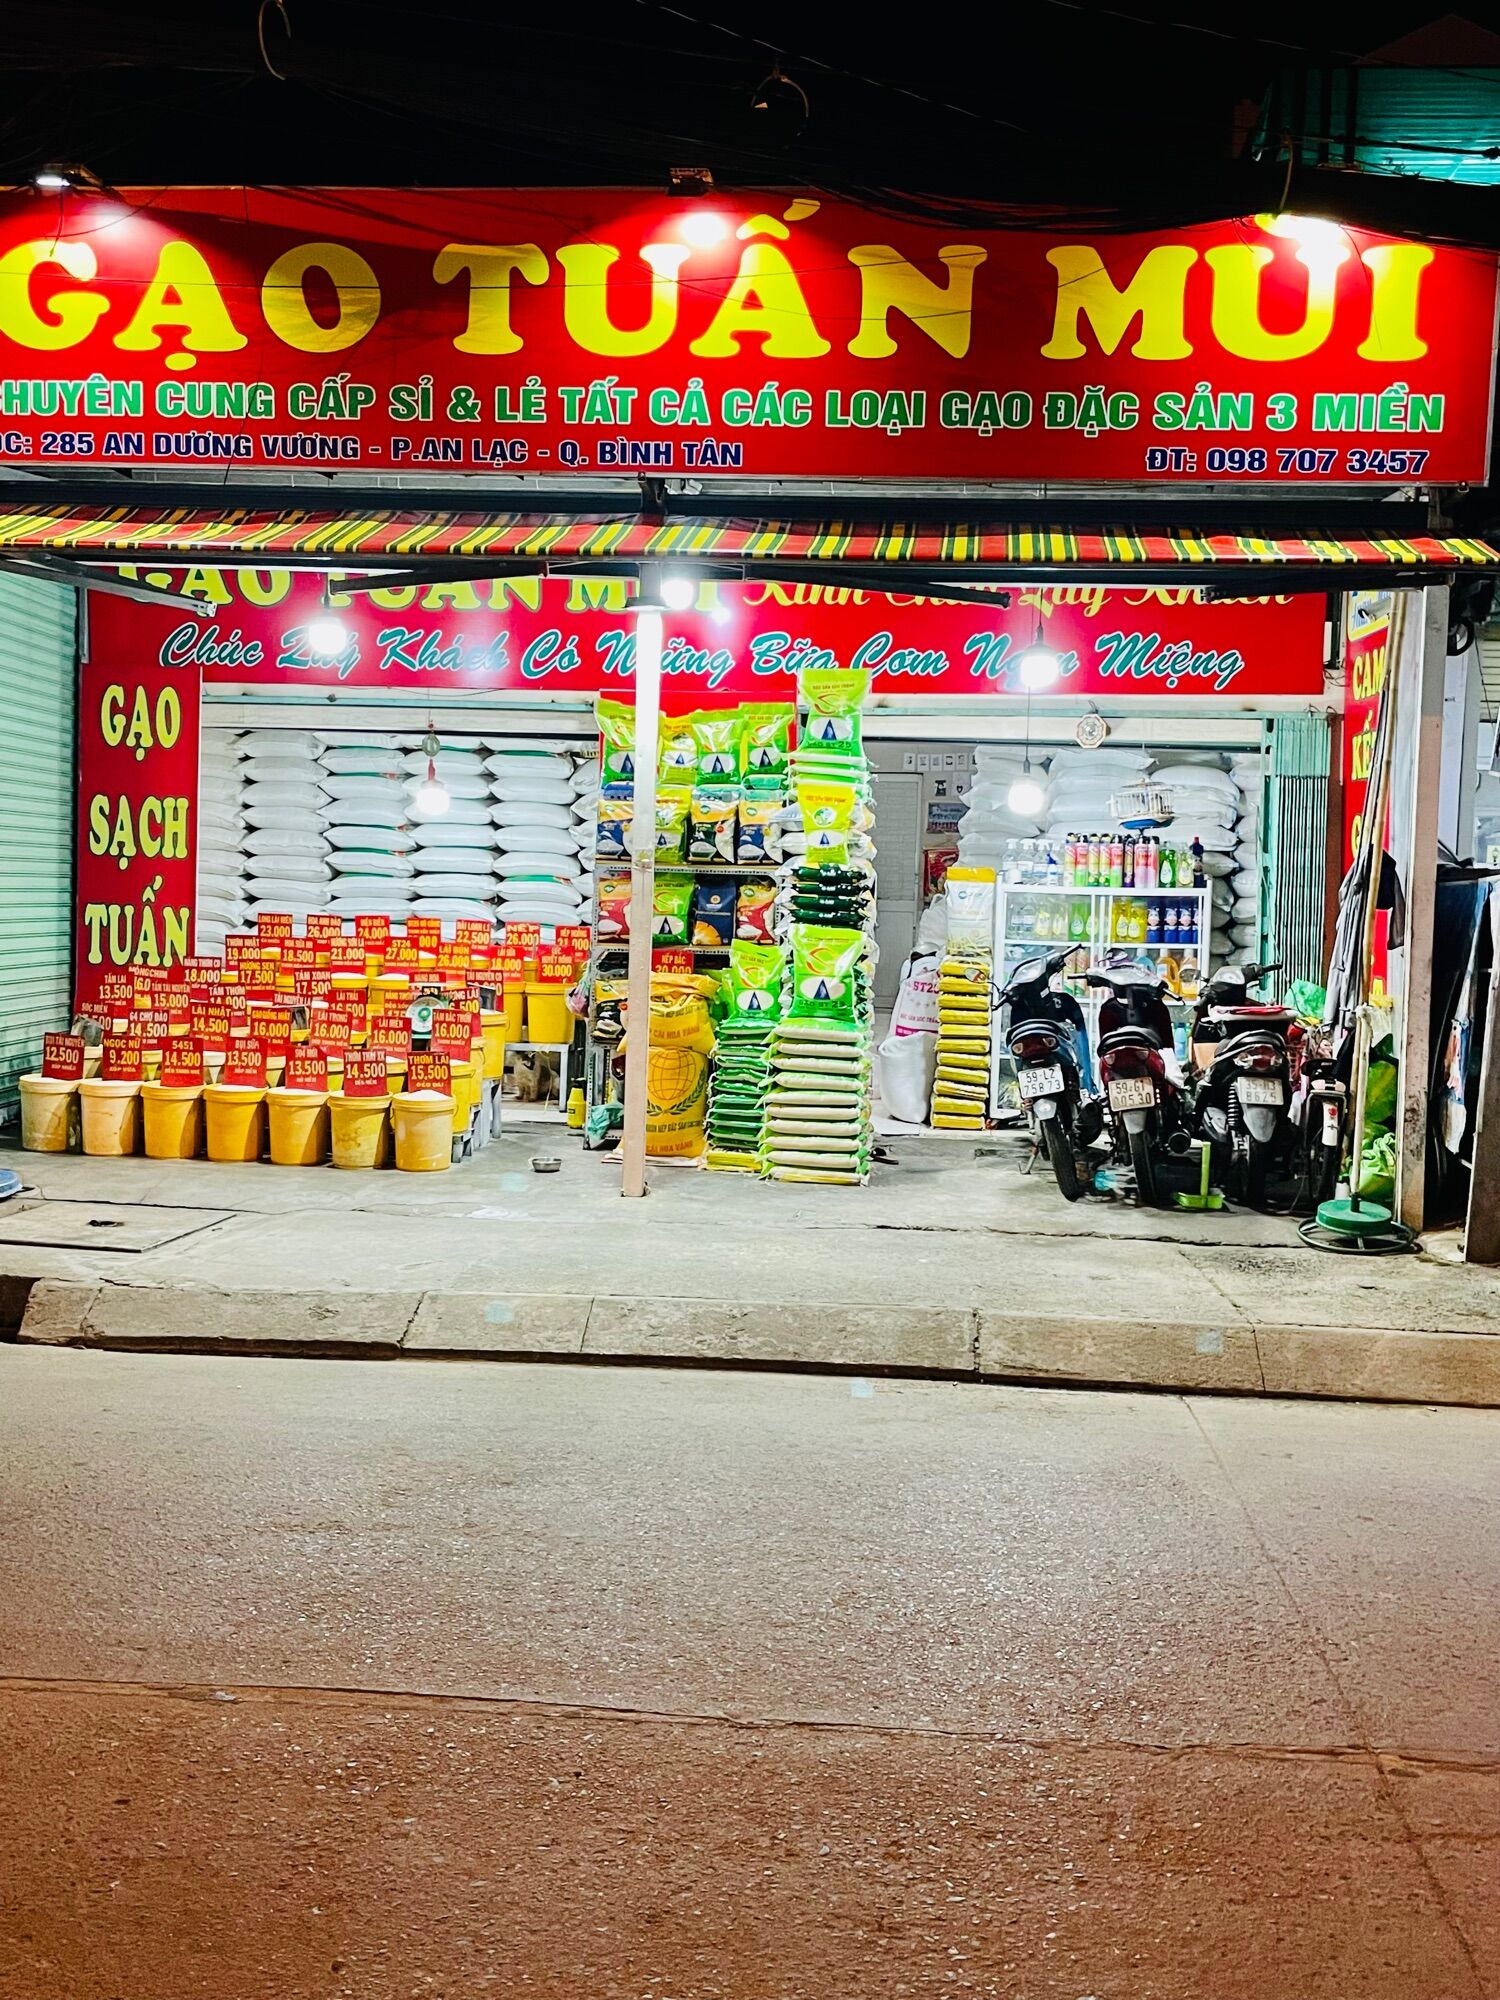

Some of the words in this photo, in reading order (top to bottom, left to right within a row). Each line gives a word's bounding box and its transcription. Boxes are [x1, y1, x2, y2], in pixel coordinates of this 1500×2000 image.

[0, 240, 381, 372] GẠO
[432, 197, 831, 360] TUẤN
[0, 373, 143, 417] HUYÊN
[156, 381, 275, 419] CUNG
[289, 373, 376, 420] CẤP
[388, 375, 433, 422] SỈ
[447, 385, 481, 422] &
[495, 376, 546, 423] LẺ
[558, 377, 638, 425] TẤT
[650, 378, 711, 426] CẢ
[722, 382, 812, 427] CÁC
[826, 389, 926, 436] LOẠI
[940, 391, 1032, 437] GẠO
[1044, 386, 1139, 438] ĐẶC
[1154, 382, 1252, 432] SẢN
[1266, 393, 1298, 432] 3
[1313, 382, 1444, 433] MIỀN
[0, 431, 32, 455] C:
[41, 432, 94, 455] 285
[102, 433, 145, 456] AN
[153, 430, 252, 458] DƯƠNG
[261, 432, 360, 460] VƯƠNG
[391, 437, 463, 461] P.AN
[472, 438, 528, 467] LẠC
[558, 440, 589, 466] Q.
[599, 437, 672, 466] BÌNH
[682, 438, 743, 467] TÂN
[1146, 447, 1197, 472] ĐT:
[1206, 448, 1267, 473] 098
[1276, 448, 1338, 473] 707
[1346, 449, 1430, 475] 3457
[159, 622, 264, 667] Chúc
[376, 627, 510, 674] Khách
[521, 629, 580, 679] Có
[596, 630, 735, 687] Nững
[750, 631, 838, 675] Bữa
[851, 632, 949, 678] Cơm
[1095, 631, 1245, 690] Miệng
[101, 684, 182, 761] GẠO
[89, 794, 189, 871] SẠCH
[84, 875, 190, 968] TUẤN
[260, 925, 291, 937] 23.000
[308, 927, 341, 938] 26.000
[392, 940, 411, 948] ST24
[507, 934, 540, 946] 26.000
[227, 947, 260, 960] 19.000
[283, 949, 315, 963] 18.500
[330, 948, 365, 960] 21.000
[385, 948, 417, 961] 27.000
[438, 955, 470, 967] 26.000
[491, 958, 521, 971] 18.000
[542, 964, 572, 977] 30.000
[184, 969, 220, 983] 18.000
[240, 971, 274, 984] 17.500
[99, 985, 133, 999] 13.500
[296, 981, 331, 995] 17.500
[154, 993, 189, 1008] 15.000
[129, 1022, 167, 1037] 14.500
[192, 1017, 229, 1034] 14.500
[253, 1021, 290, 1038] 16.000
[314, 1022, 350, 1040] 16.000
[434, 1023, 470, 1039] 16.000
[172, 1040, 194, 1050] 5451
[373, 1030, 408, 1045] 16.000
[109, 1049, 140, 1065] 9.200
[165, 1050, 201, 1067] 14.500
[409, 1055, 433, 1065] THƠM
[288, 1060, 326, 1076] 13.500
[346, 1063, 386, 1079] 14.500
[1026, 1068, 1055, 1084] 59-L2
